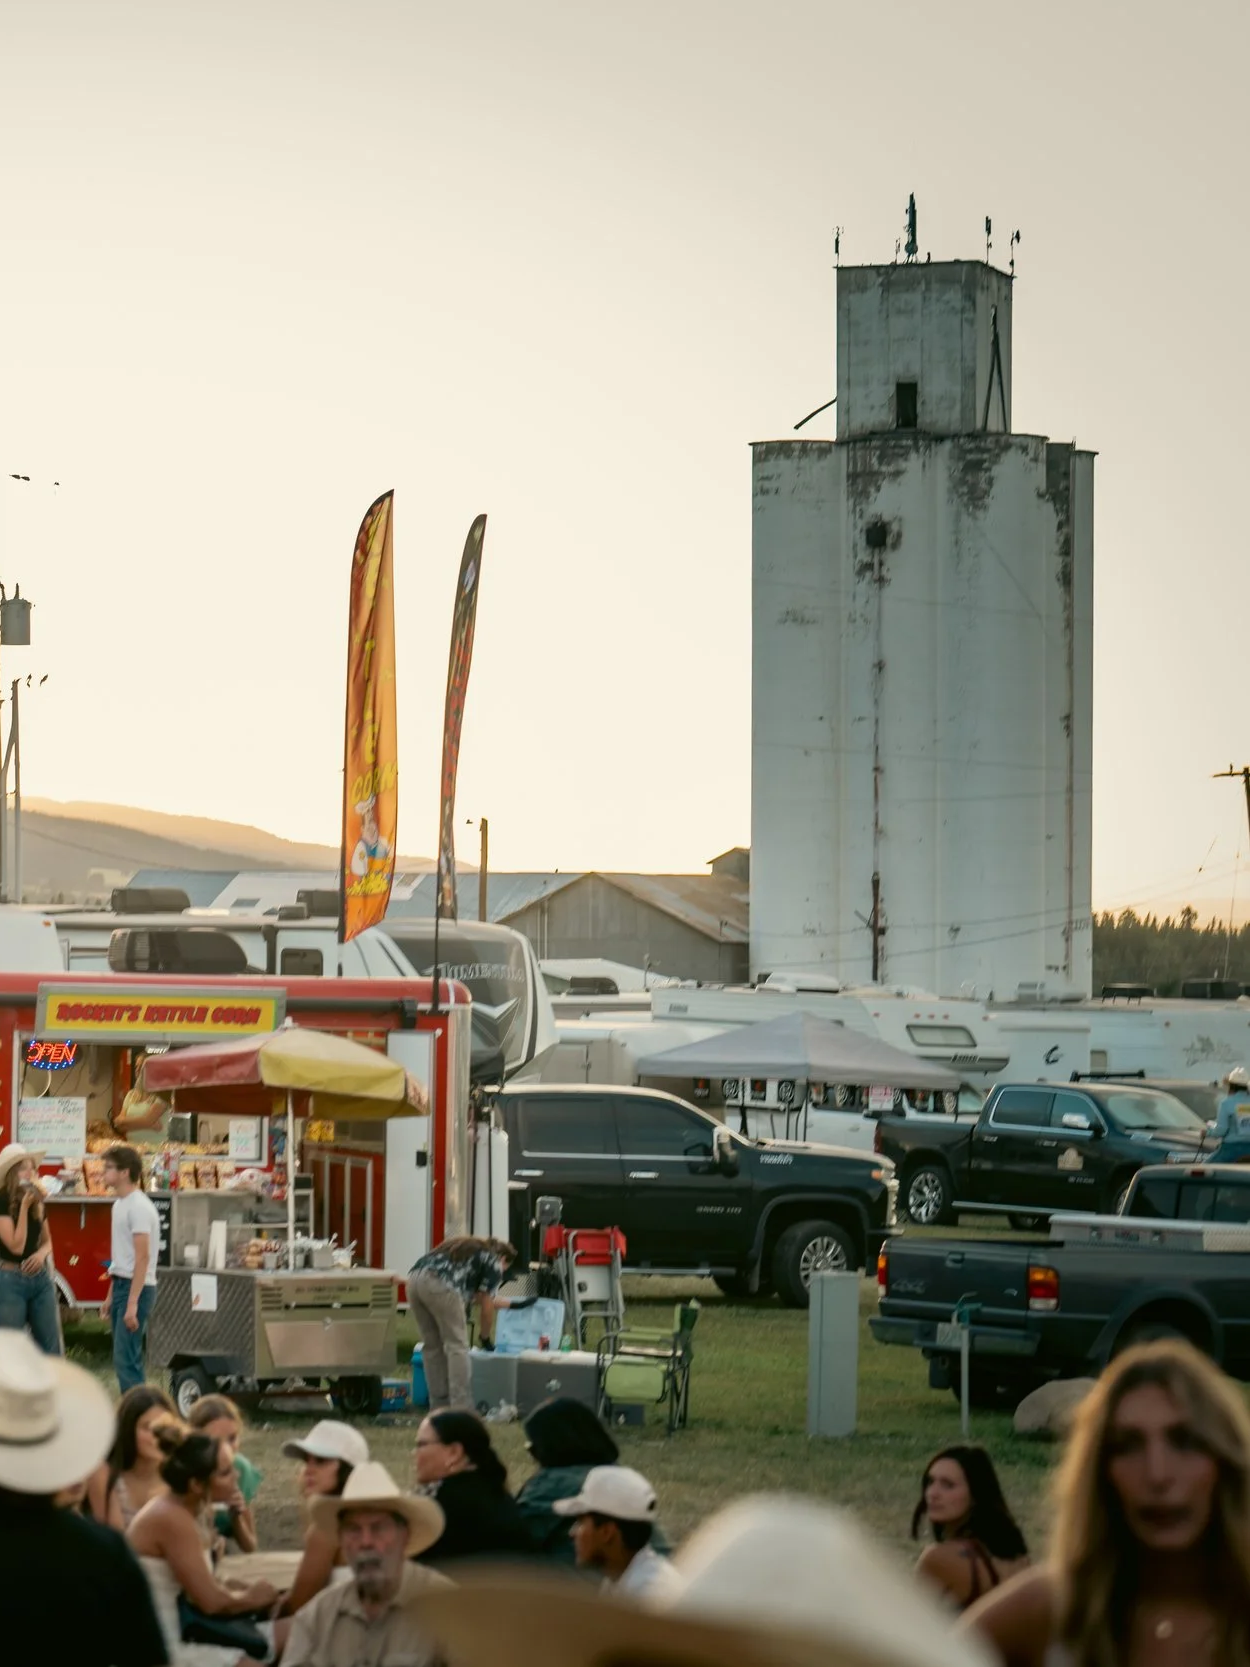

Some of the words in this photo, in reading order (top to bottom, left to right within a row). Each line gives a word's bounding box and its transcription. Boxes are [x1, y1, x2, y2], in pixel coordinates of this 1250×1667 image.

[56, 1003, 142, 1021] ROCKET'S
[143, 1004, 209, 1023] KETTLE
[211, 1006, 262, 1025] CORN
[27, 1042, 77, 1063] OPEN
